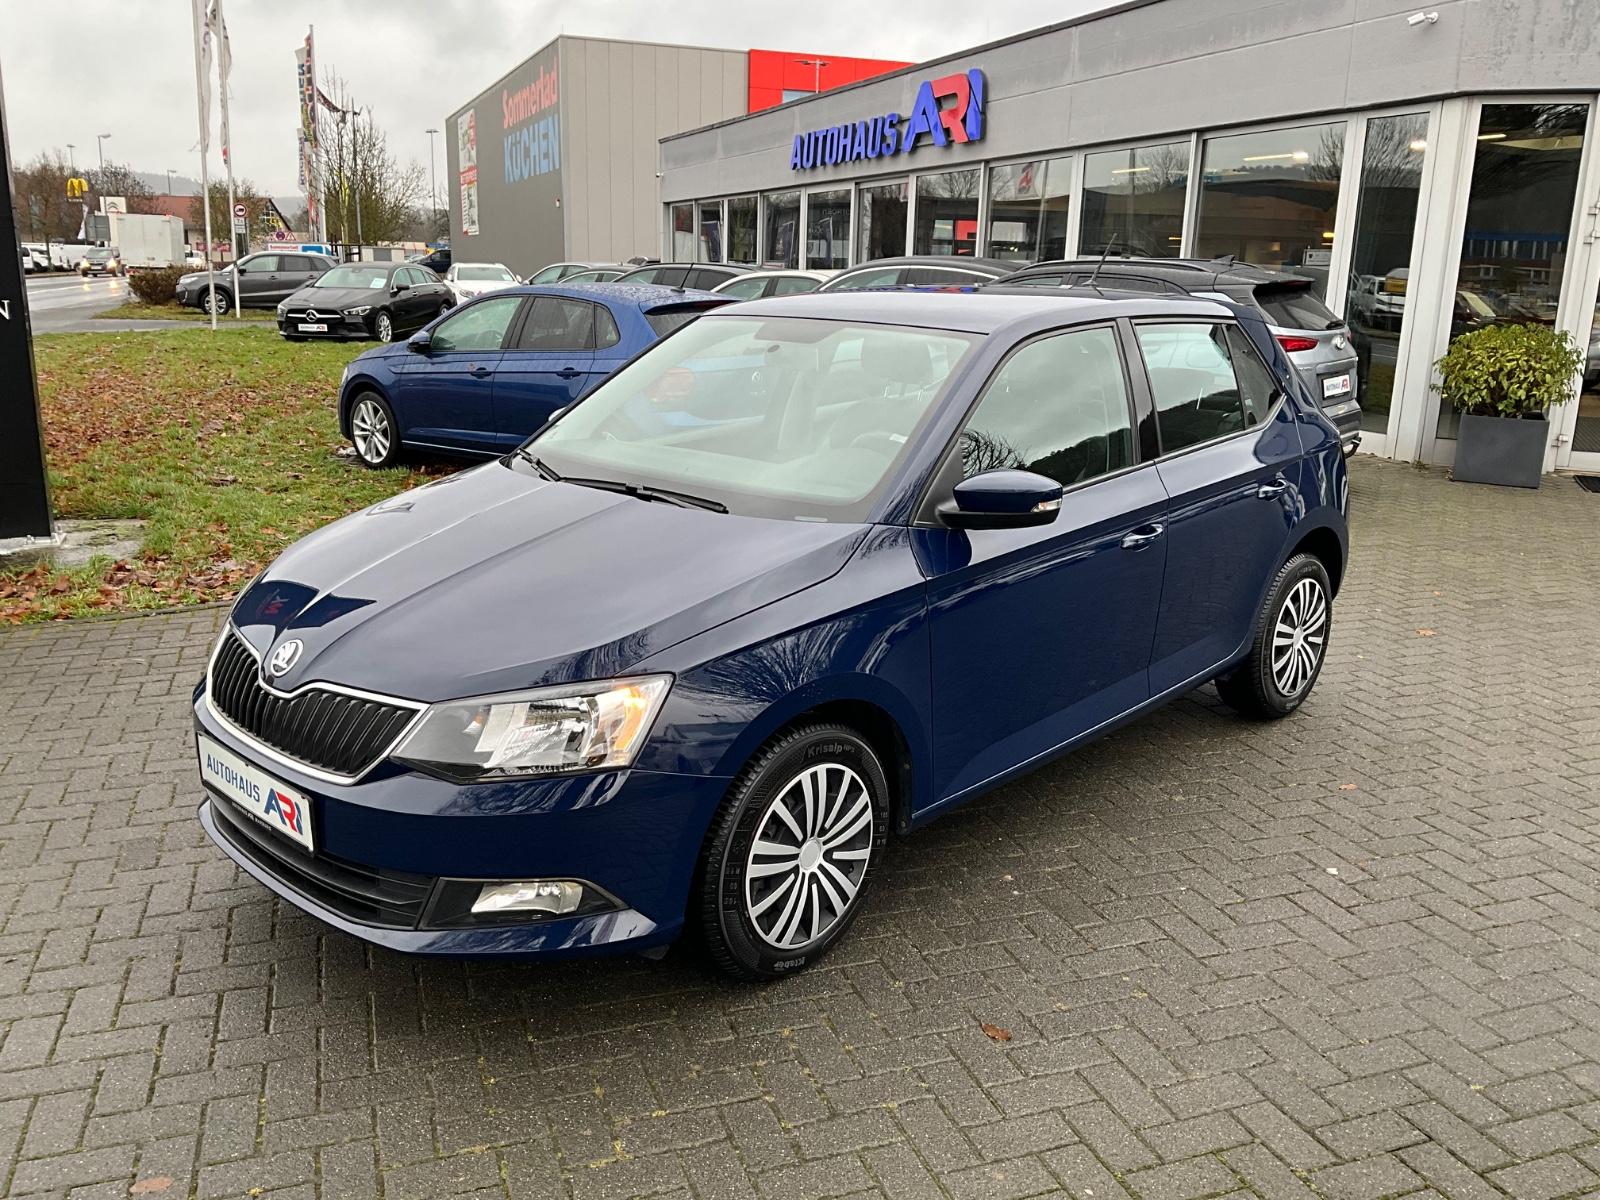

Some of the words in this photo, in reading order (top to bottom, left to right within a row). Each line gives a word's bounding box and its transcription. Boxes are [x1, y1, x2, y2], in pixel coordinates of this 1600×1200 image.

[502, 60, 558, 129] Sommerlad
[791, 112, 900, 170] AUTOHAUS
[904, 68, 985, 153] ARI
[503, 114, 560, 184] KÜCHEN
[807, 742, 843, 758] Krisalp
[207, 754, 260, 803] AUTOHAUS
[264, 787, 304, 836] ARI
